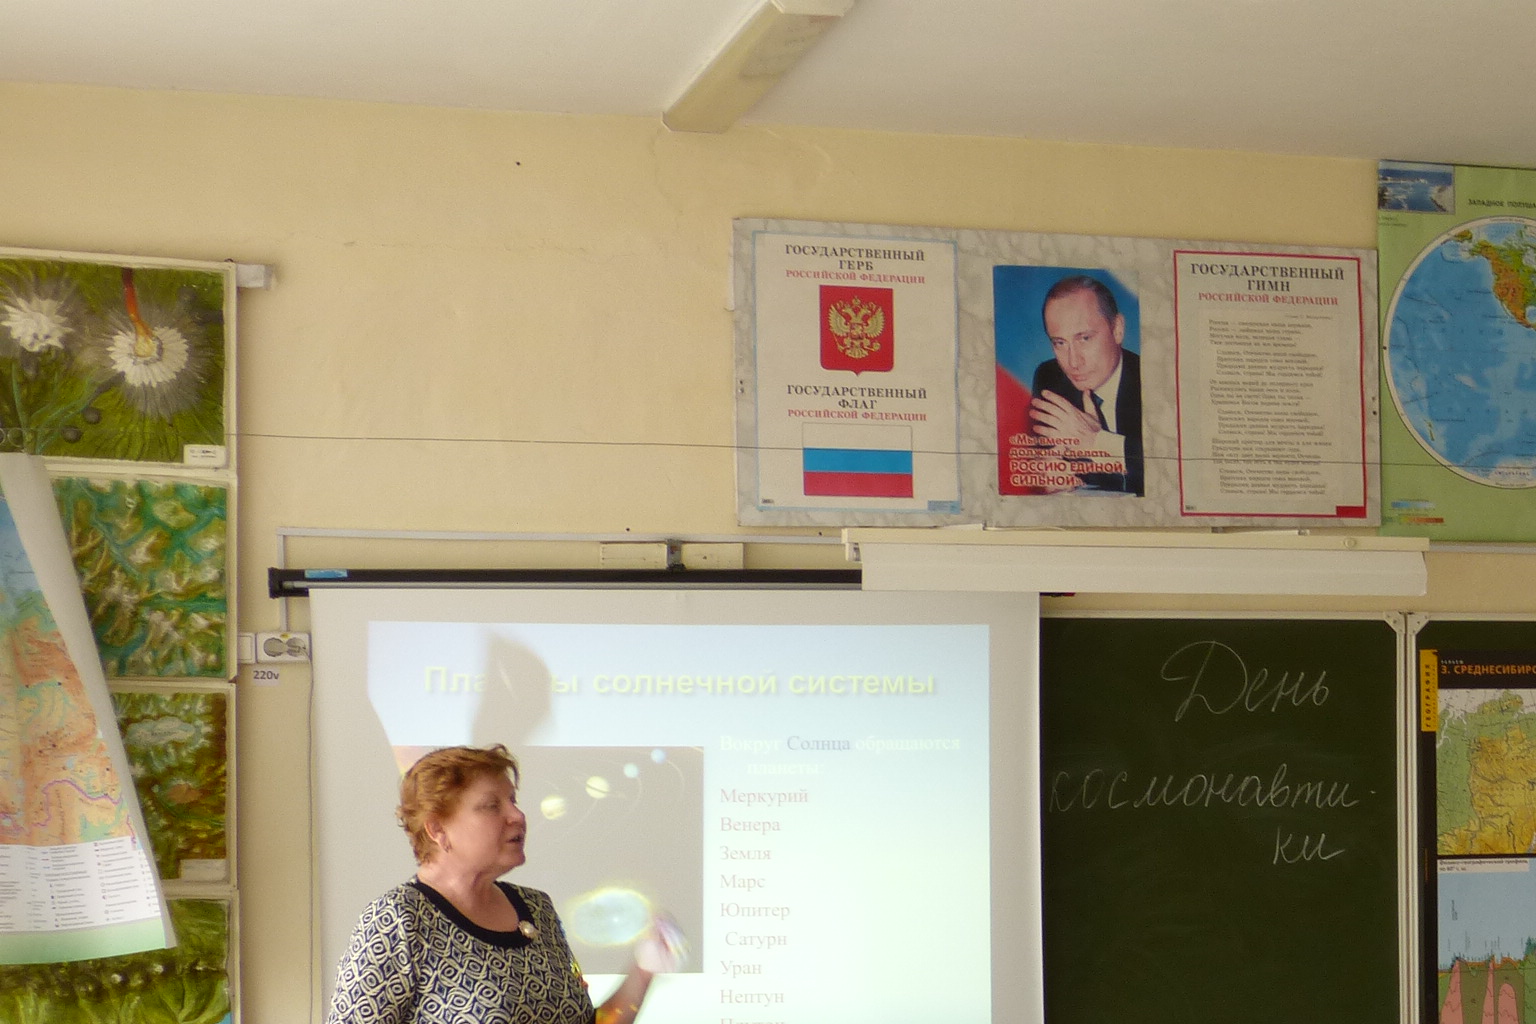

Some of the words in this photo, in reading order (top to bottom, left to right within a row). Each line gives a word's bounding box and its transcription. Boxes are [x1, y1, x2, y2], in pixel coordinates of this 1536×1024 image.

[785, 244, 925, 261] ГОСУДАРСТВЕННЫЙ
[839, 260, 874, 271] ГЕРБ
[1191, 263, 1345, 280] ГОСУДАРСТВЕННЫЙ
[786, 270, 857, 281] РОССИЙСКОЙ
[859, 273, 925, 284] ФЕДЕРАЦИИ
[1247, 279, 1291, 292] ГИМН
[1198, 292, 1270, 303] РОССИЙСКОЙ
[1272, 295, 1338, 306] ФЕДЕРАЦИИ
[787, 384, 927, 399] ГОСУДАРСТВЕННЫЙ
[838, 399, 878, 410] ФЛАГ
[788, 409, 858, 420] РОССИЙСКОЙ
[862, 411, 927, 422] ФЕДЕРАЦИИ
[1009, 448, 1060, 459] должны
[1010, 461, 1067, 473] РОССИЮ
[253, 670, 280, 680] 220v
[1441, 664, 1451, 675] 3.
[424, 666, 578, 694] Плаы
[592, 668, 778, 695] солнечной
[788, 673, 936, 695] системы
[1160, 640, 1329, 722] День
[719, 735, 781, 755] Вокруг
[787, 735, 851, 752] Солнца
[720, 788, 809, 807] Меркурий
[720, 816, 781, 836] Венера
[719, 845, 772, 861] Земля
[1272, 827, 1346, 865] ки
[720, 874, 766, 892] Марс
[720, 902, 791, 921] Юпитер
[725, 931, 788, 949] Сатурн
[720, 960, 762, 979] Уран
[720, 989, 785, 1007] Нептун
